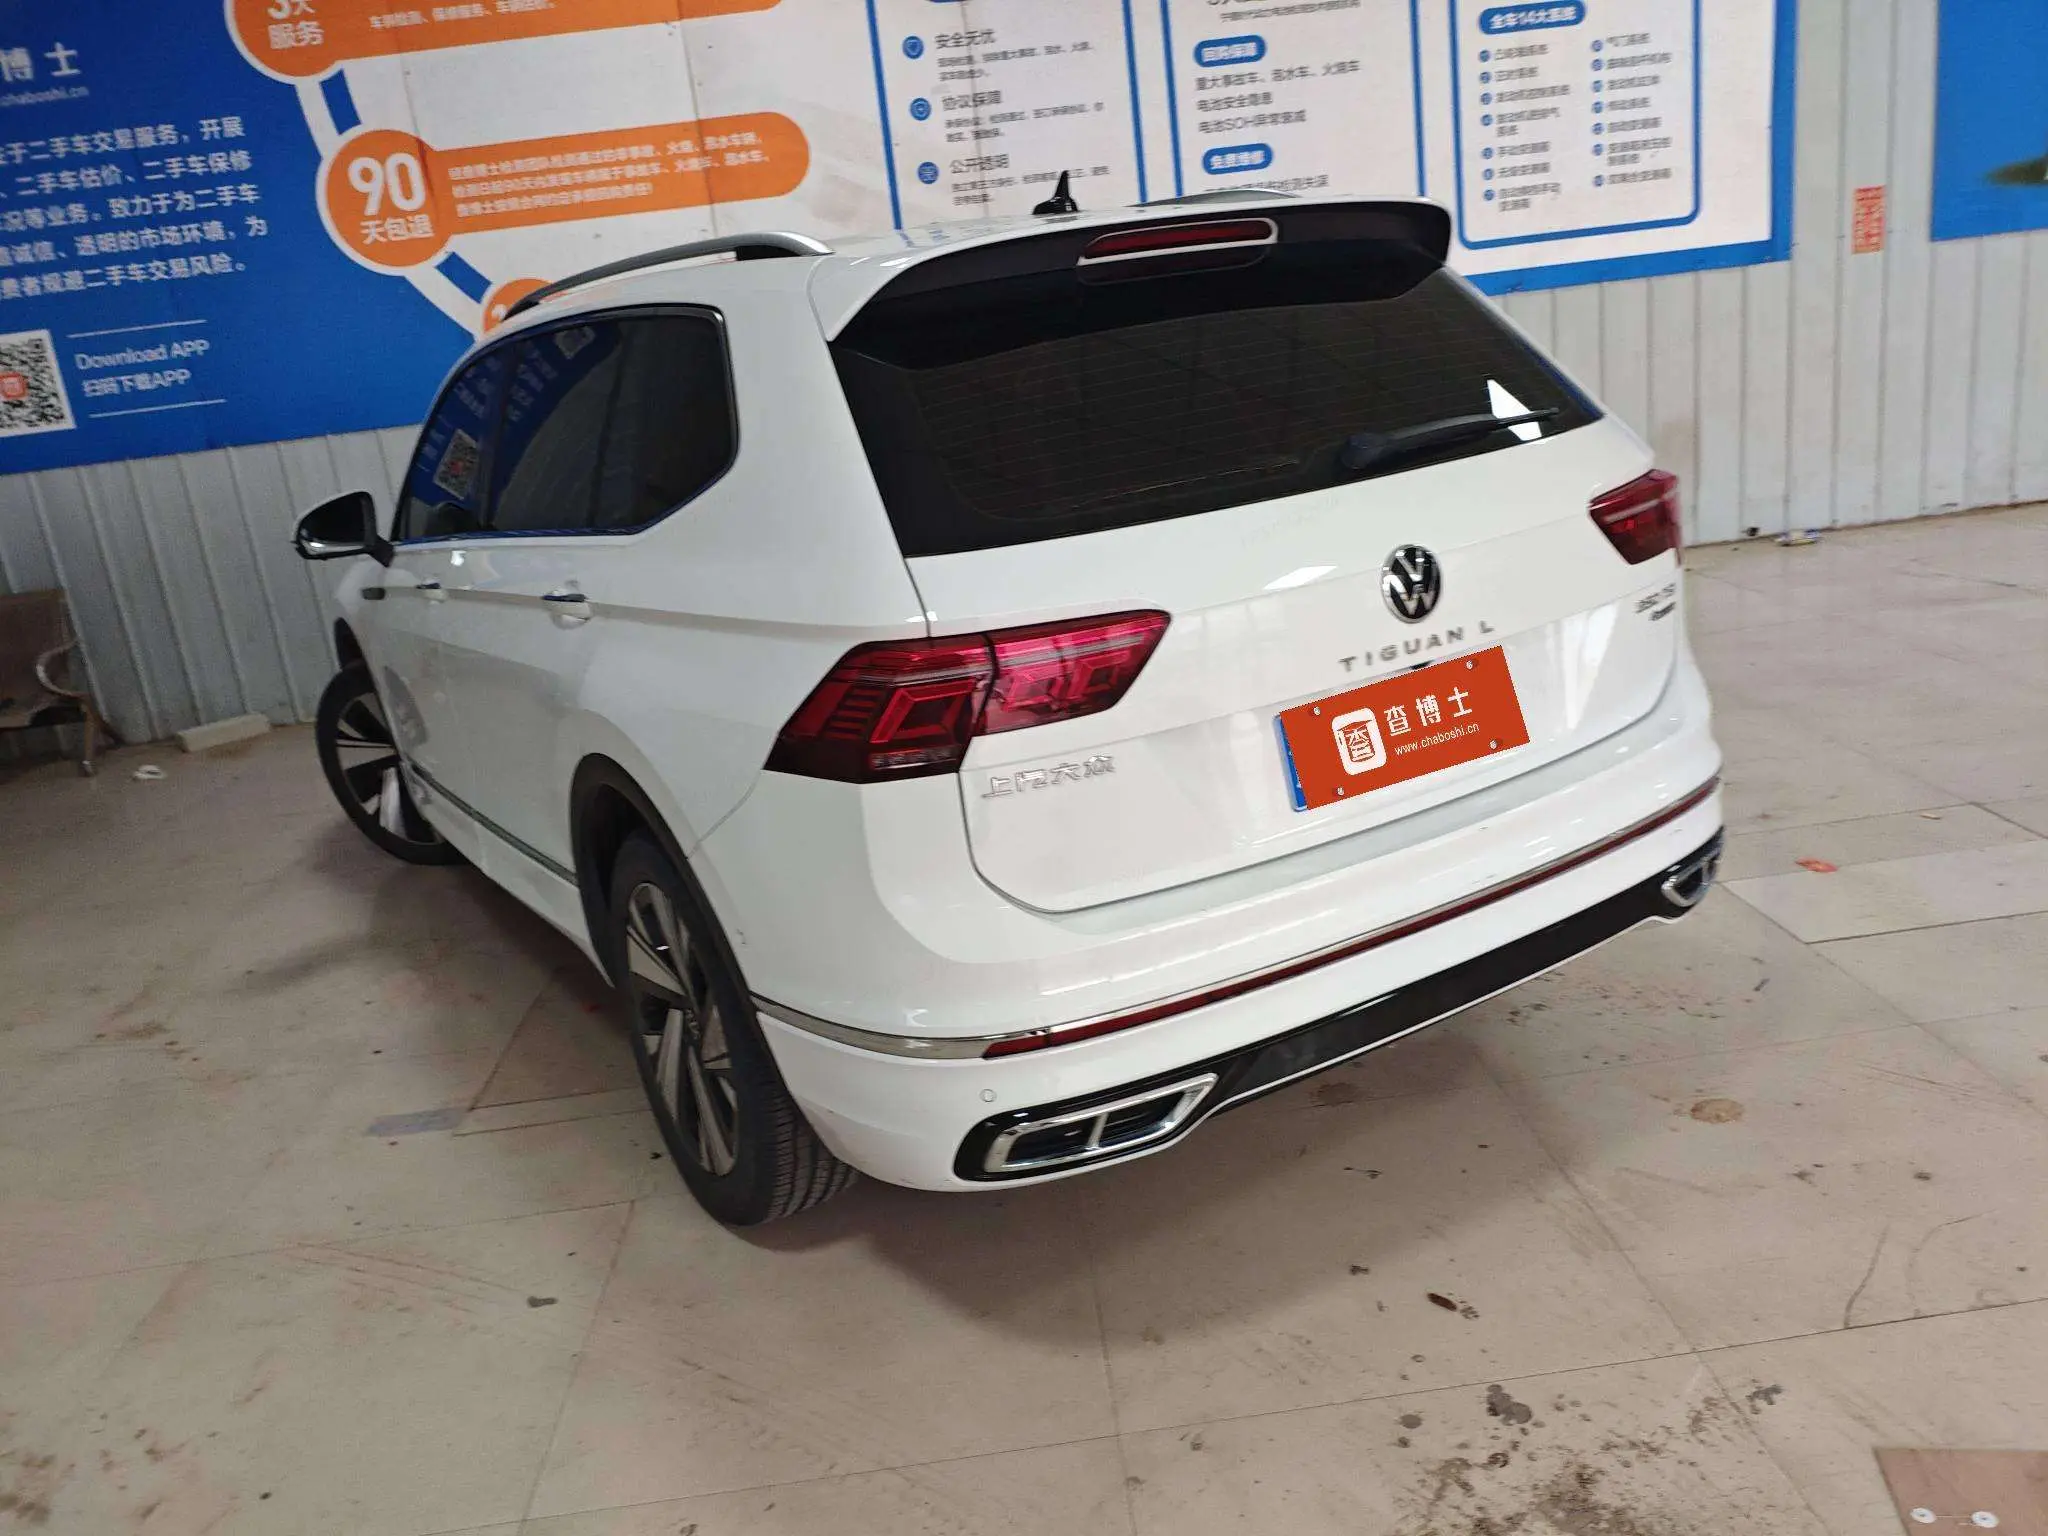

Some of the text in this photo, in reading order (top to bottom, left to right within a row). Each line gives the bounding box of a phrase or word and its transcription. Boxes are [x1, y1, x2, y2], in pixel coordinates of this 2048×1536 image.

[268, 21, 324, 49] 服务
[348, 153, 426, 216] 90
[360, 214, 435, 245] 天包退
[74, 339, 210, 370] Download APP
[1339, 620, 1495, 673] TIGUAN L
[981, 755, 1114, 798] 上汽大众
